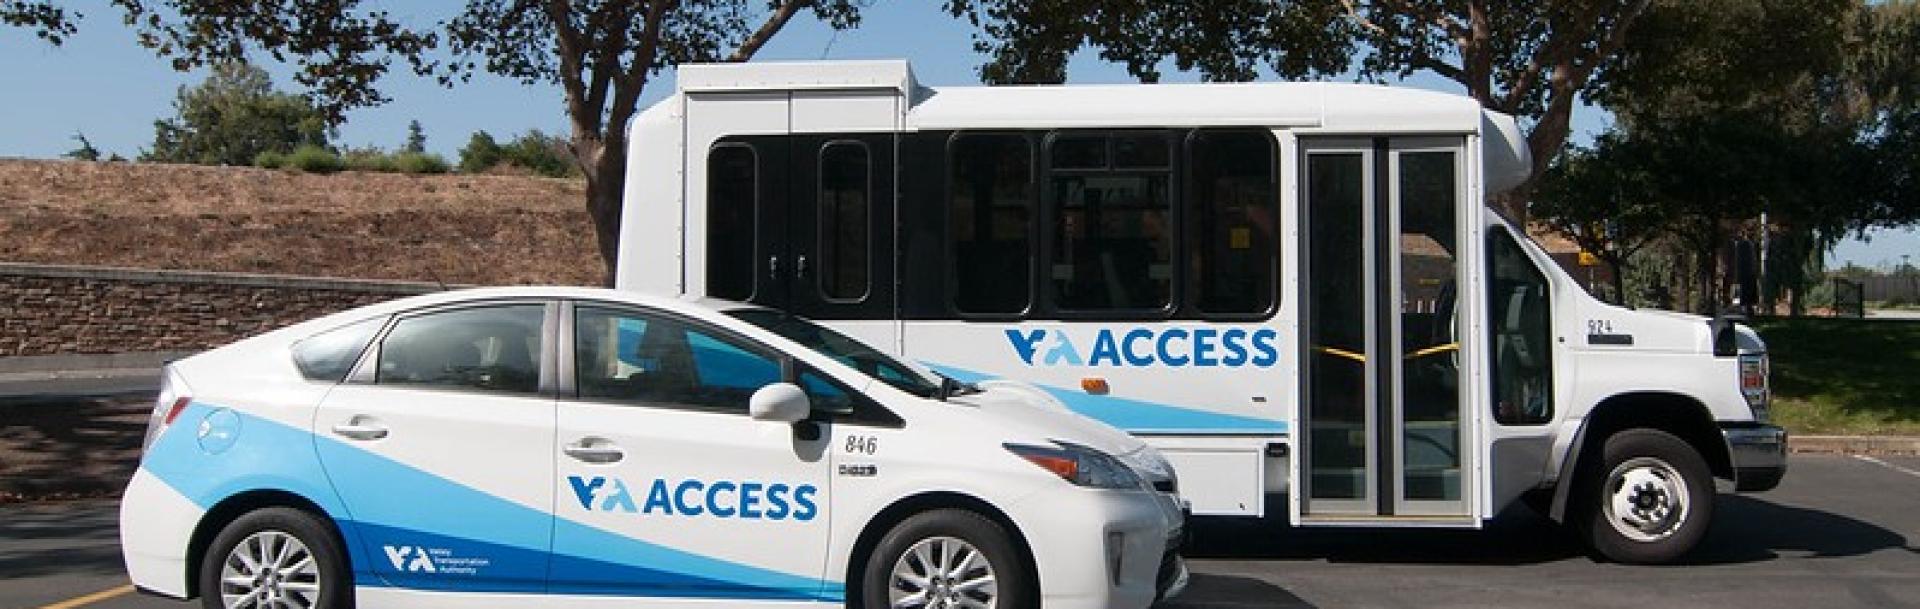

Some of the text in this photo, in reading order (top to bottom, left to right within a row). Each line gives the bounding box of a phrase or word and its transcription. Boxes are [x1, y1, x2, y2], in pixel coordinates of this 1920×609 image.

[1088, 329, 1278, 366] ACCESS
[845, 435, 877, 455] 846
[642, 479, 818, 521] ACCESS
